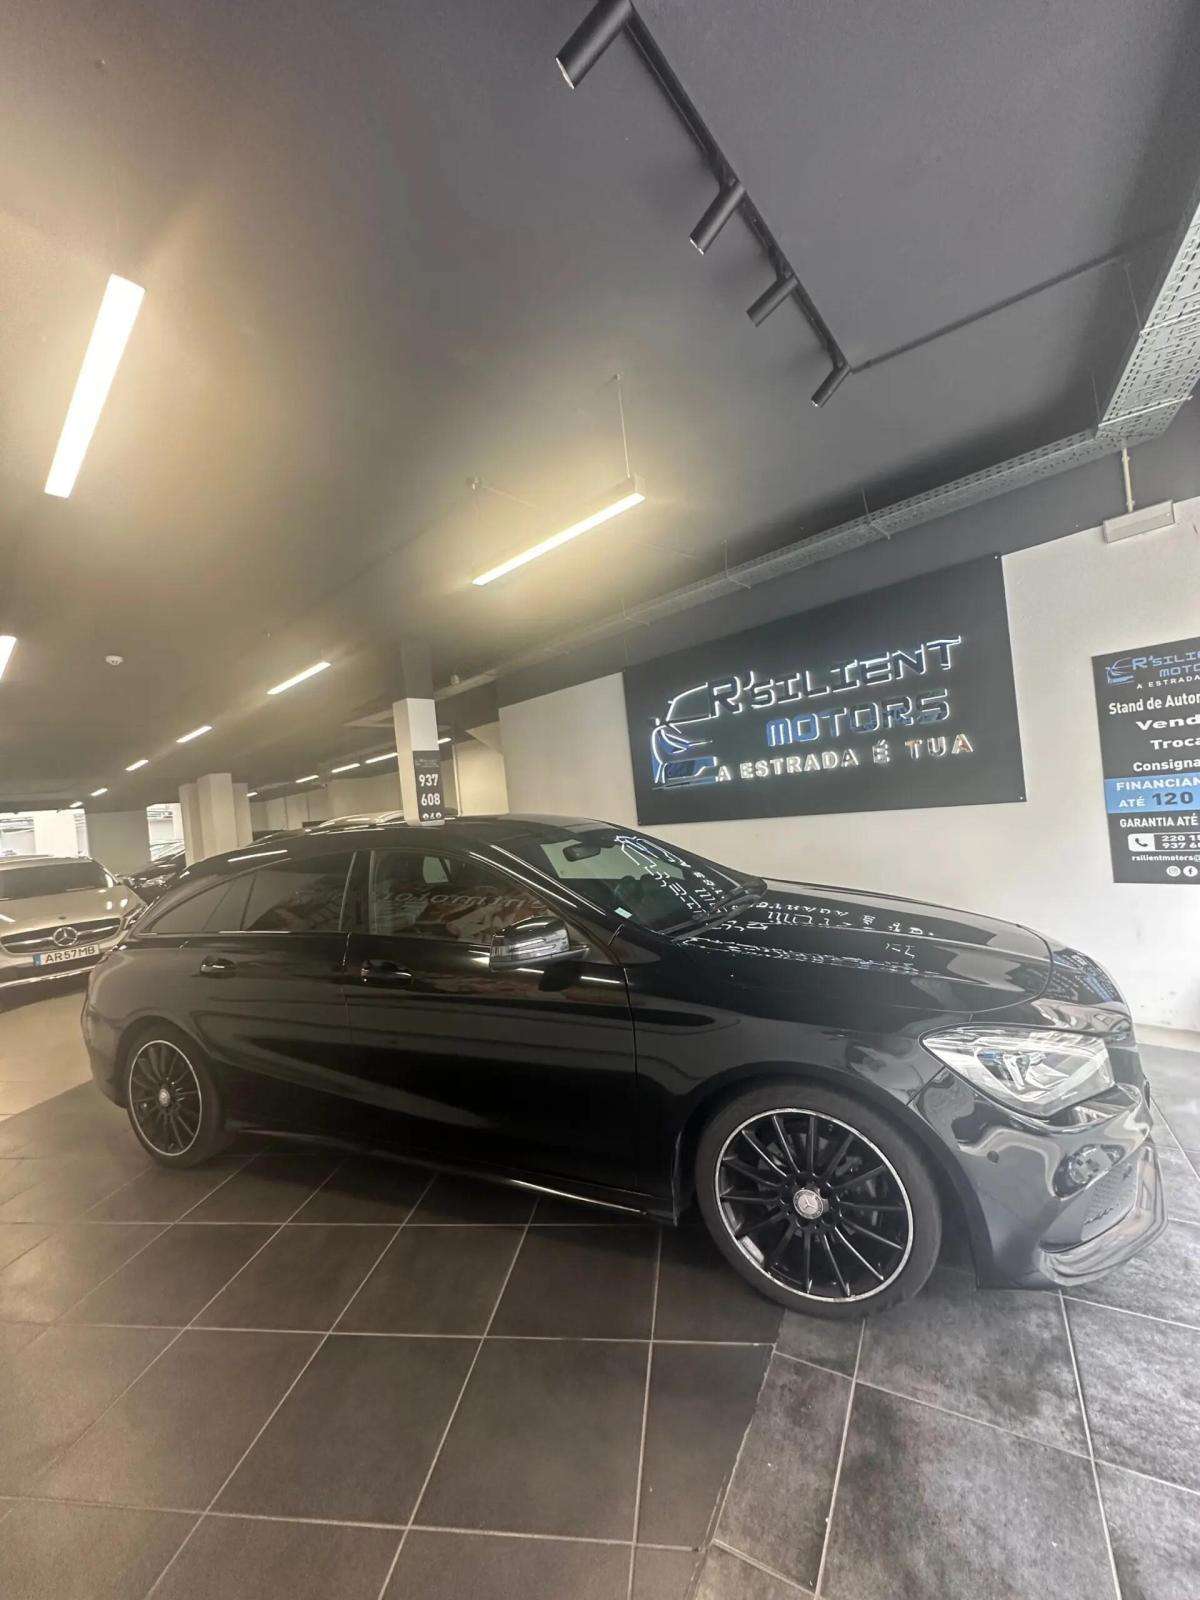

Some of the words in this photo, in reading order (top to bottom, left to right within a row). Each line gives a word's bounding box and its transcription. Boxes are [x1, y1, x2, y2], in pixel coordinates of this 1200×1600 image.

[1148, 675, 1200, 687] ESTRADA
[1109, 699, 1144, 714] Stand
[1147, 697, 1162, 710] de
[766, 688, 951, 747] MOTORS
[715, 764, 732, 782] A
[740, 749, 859, 780] ESTRADA
[872, 739, 890, 764] É
[904, 734, 974, 759] TUA
[1133, 759, 1200, 772] Consigna
[419, 774, 438, 787] 937
[421, 793, 440, 806] 608
[1118, 795, 1145, 808] ATÉ
[1152, 791, 1194, 806] 120
[1120, 816, 1174, 828] GARANTIA
[1177, 813, 1199, 826] ATÉ
